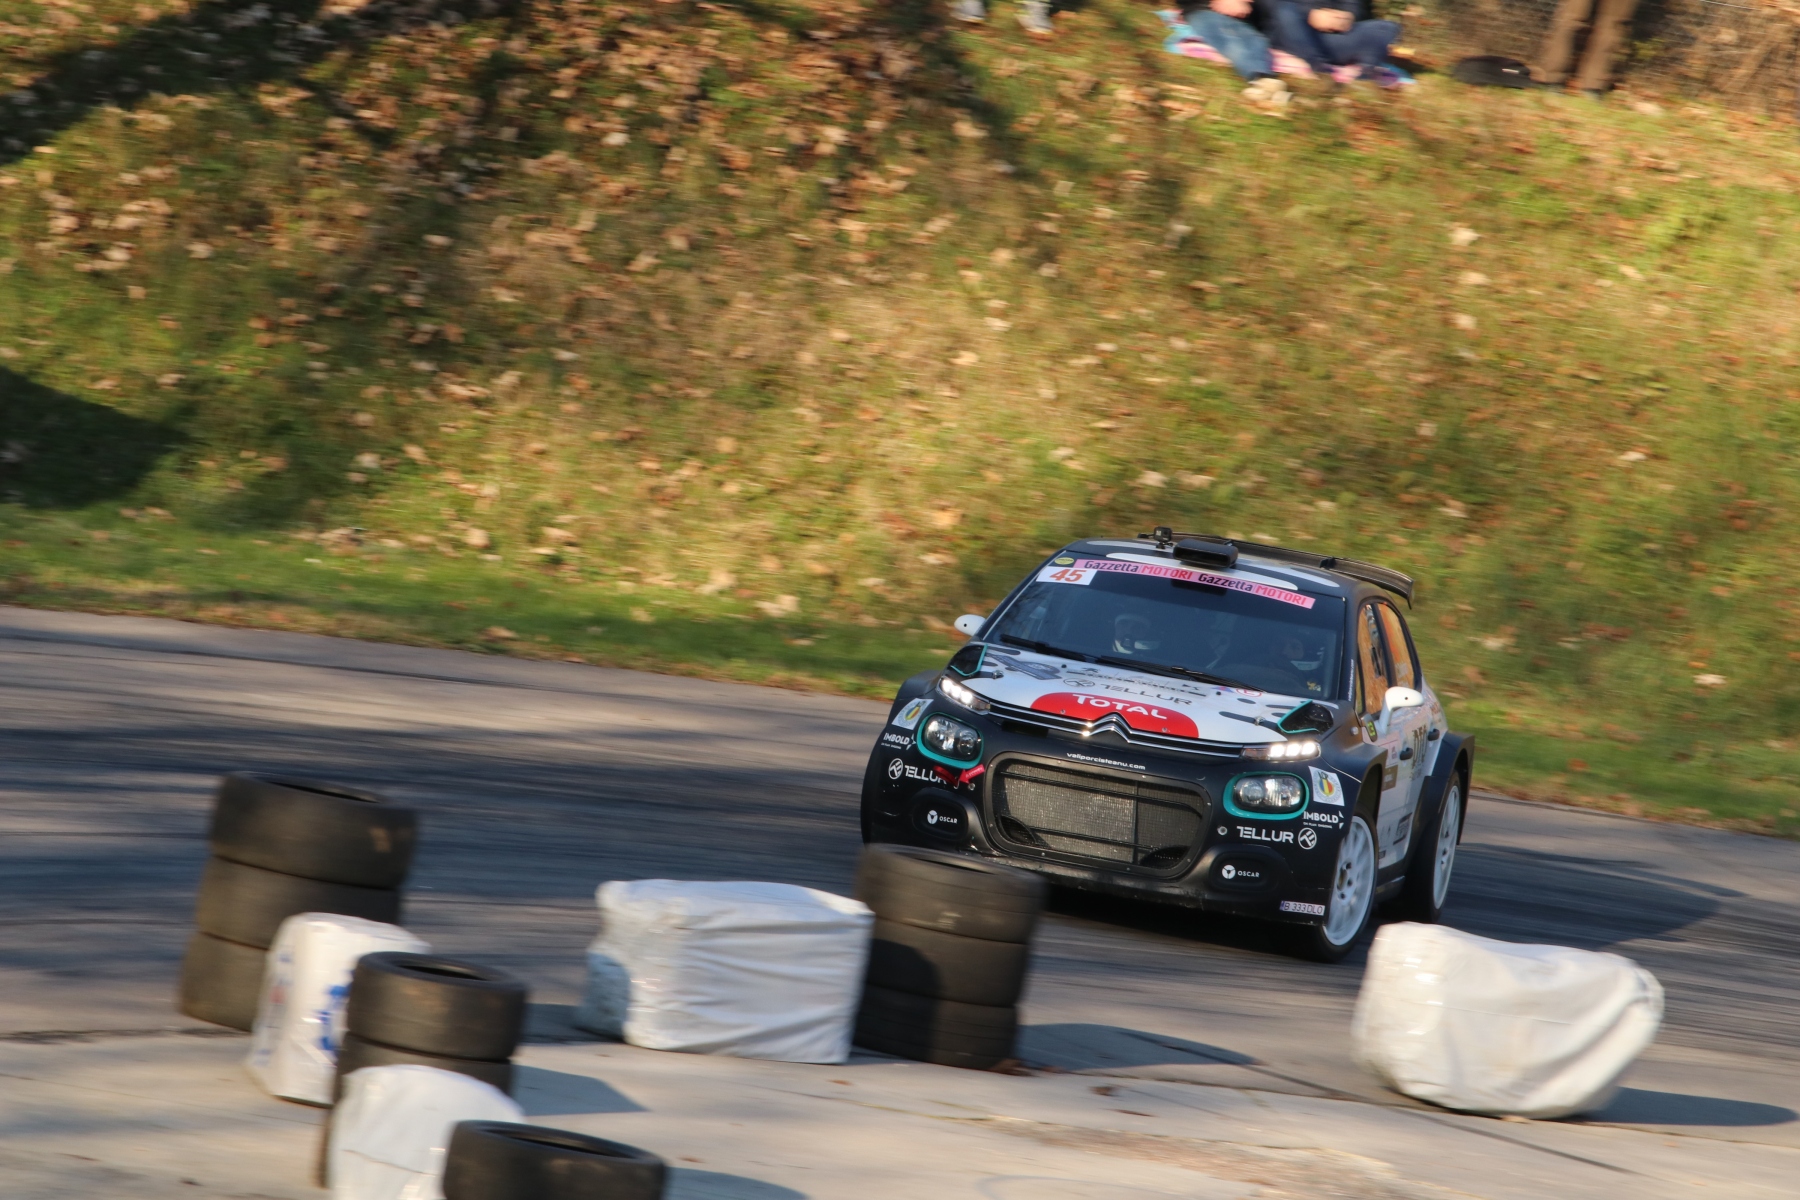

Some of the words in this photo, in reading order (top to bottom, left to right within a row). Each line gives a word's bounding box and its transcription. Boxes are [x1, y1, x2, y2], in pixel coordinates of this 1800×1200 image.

[1049, 568, 1083, 582] 45
[1083, 560, 1139, 573] Gazzetta
[1141, 565, 1192, 580] MOTORI
[1198, 573, 1254, 591] Gazzetta
[1255, 585, 1306, 605] MOTORI
[1100, 683, 1193, 706] TELLUR
[1072, 694, 1167, 719] TOTAL
[883, 733, 910, 745] IMBOLD
[1066, 752, 1146, 770] valiporcisteanu.com
[1303, 811, 1338, 823] IMBOLD
[1236, 826, 1294, 843] TELLUR
[1237, 870, 1259, 878] OSCAR
